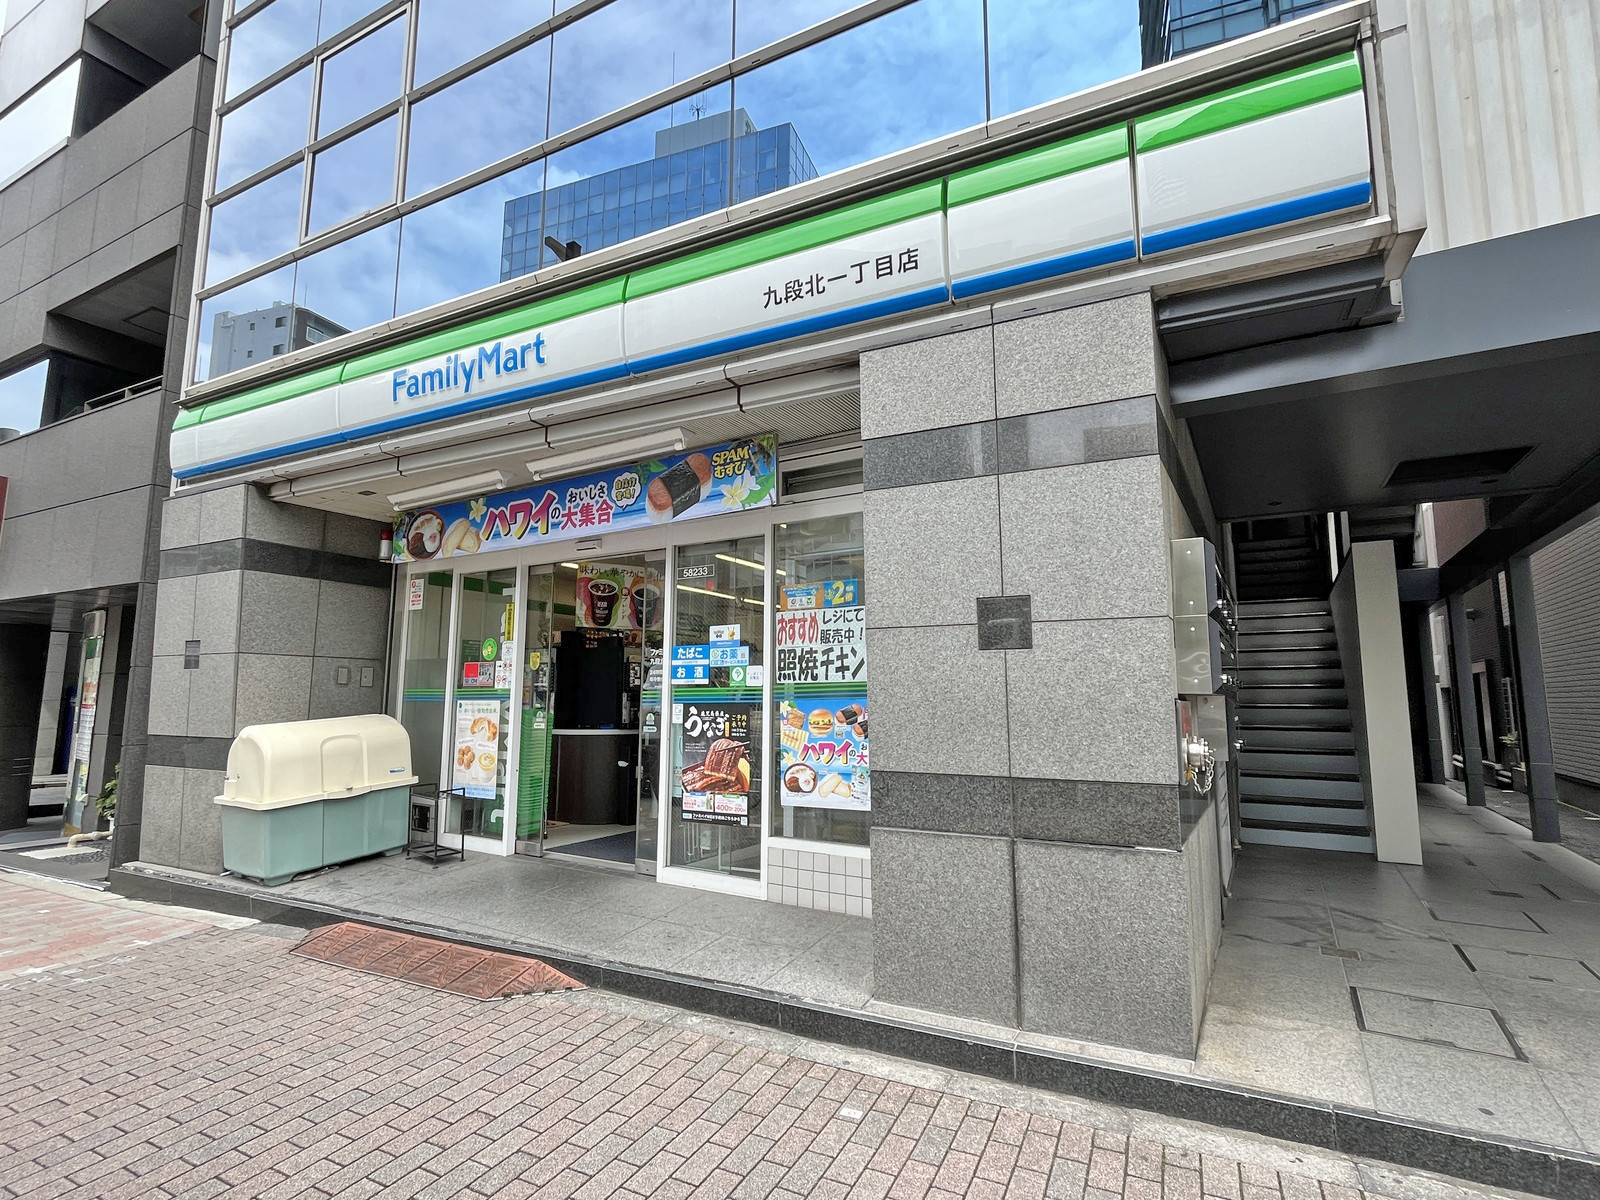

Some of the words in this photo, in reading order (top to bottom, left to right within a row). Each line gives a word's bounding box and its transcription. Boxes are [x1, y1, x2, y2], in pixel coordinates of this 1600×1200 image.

[763, 248, 919, 309] 九段北一丁目店
[392, 332, 545, 402] FamilyMart
[712, 445, 750, 466] SPAM
[714, 461, 747, 478] むすび
[567, 484, 606, 504] おいしさ
[561, 499, 614, 530] 大集合
[683, 566, 708, 577] 58233
[822, 608, 865, 625] レジにて
[777, 612, 819, 646] おすすめ
[677, 646, 704, 659] たばこ
[720, 649, 738, 660] お薬
[777, 646, 865, 682] 照焼チキン
[684, 706, 730, 738] うなぎ
